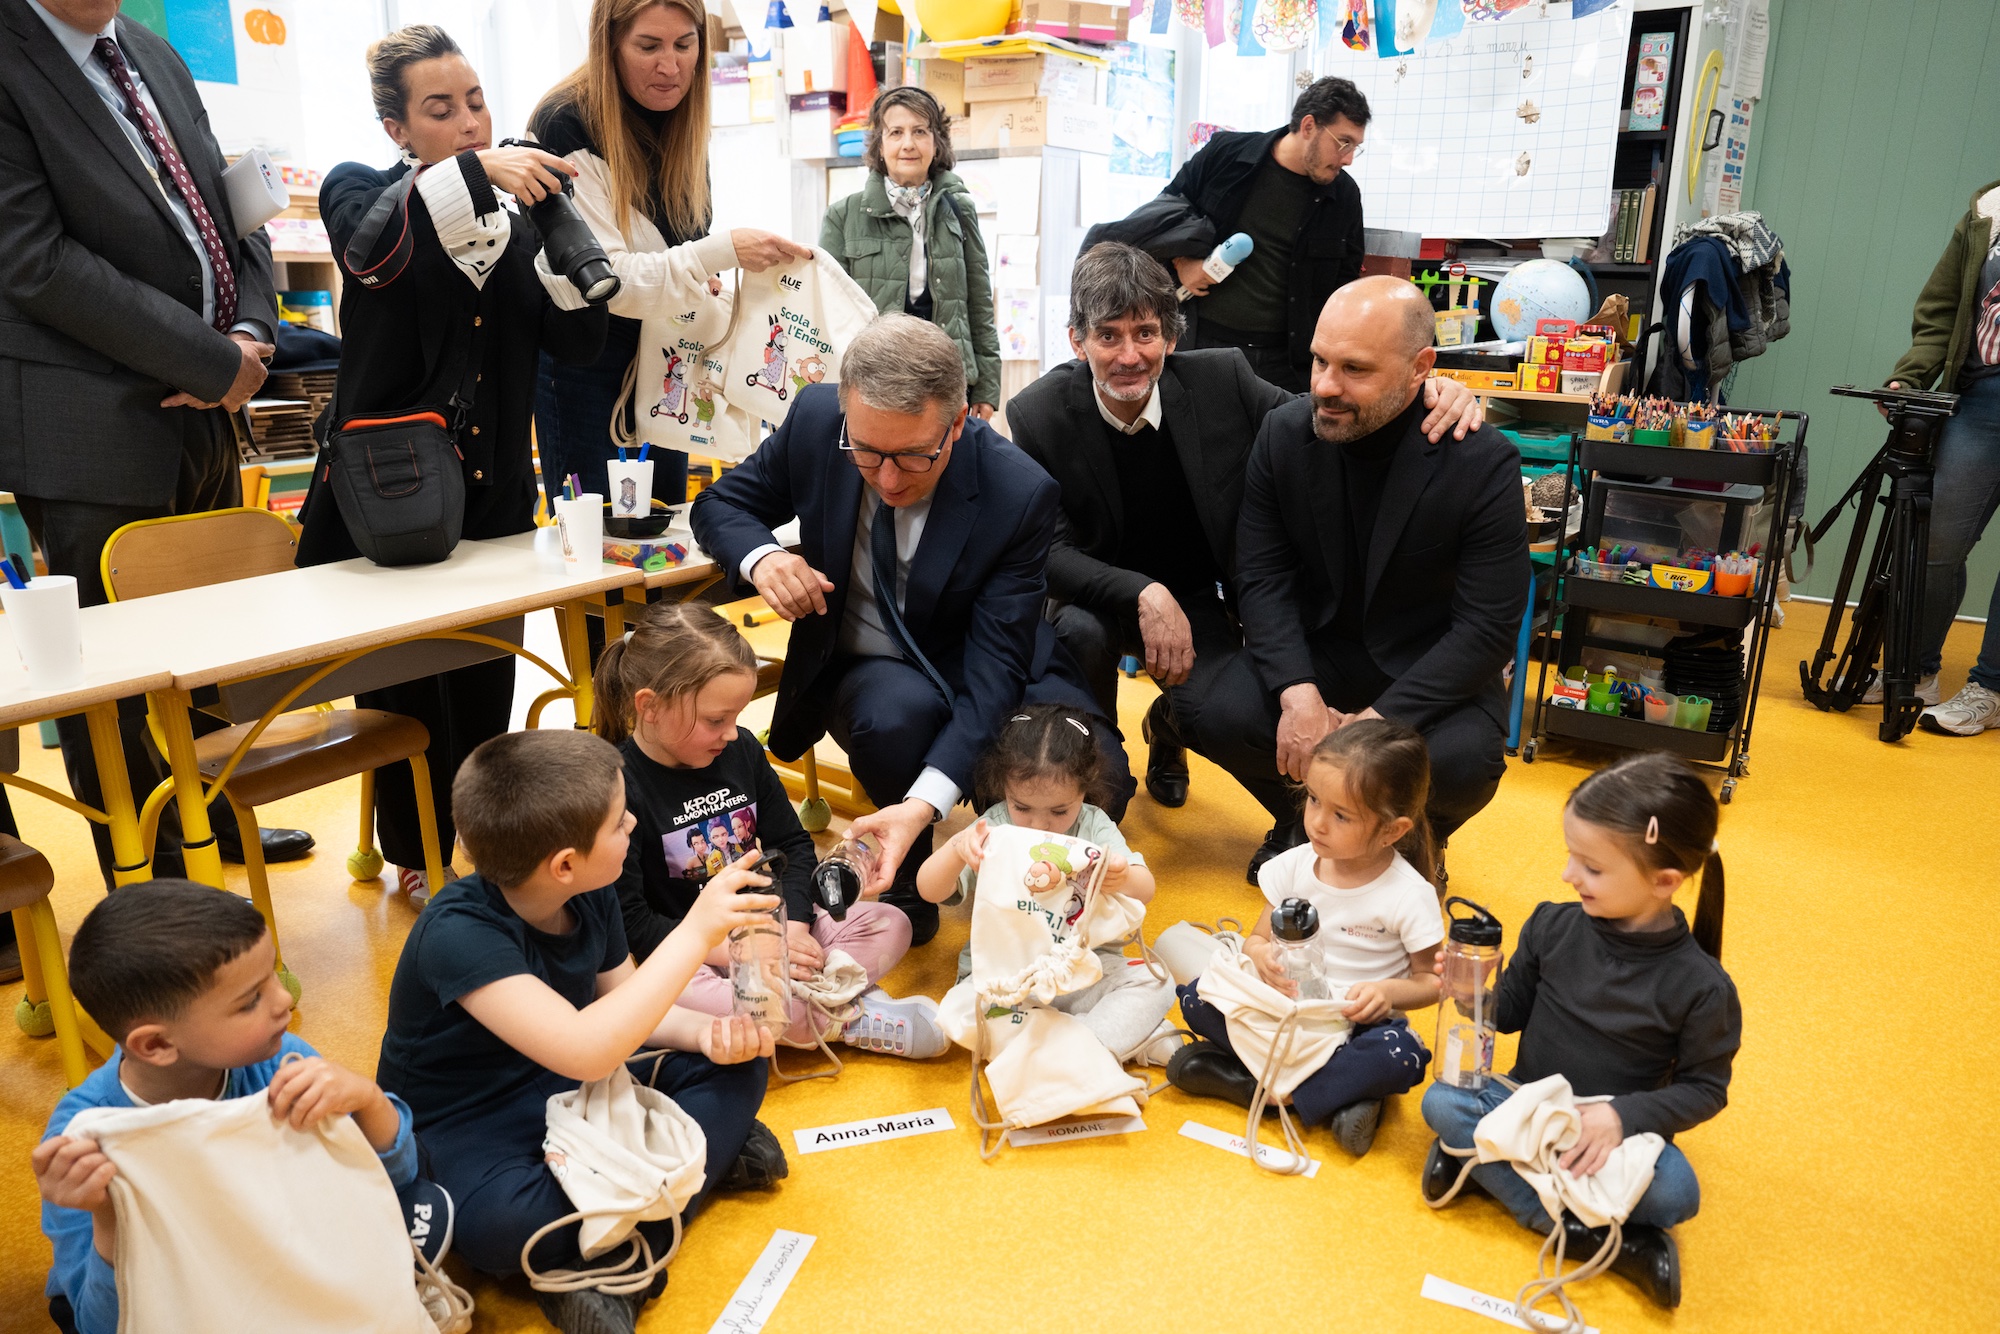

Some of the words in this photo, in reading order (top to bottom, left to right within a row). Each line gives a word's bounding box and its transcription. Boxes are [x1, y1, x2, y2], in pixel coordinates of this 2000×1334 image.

[780, 274, 803, 290] AUE
[780, 306, 810, 328] Scola
[810, 327, 820, 337] di
[787, 324, 834, 355] l'Energi
[814, 1115, 935, 1144] Anna-Maria
[1047, 1122, 1106, 1137] ROMANE
